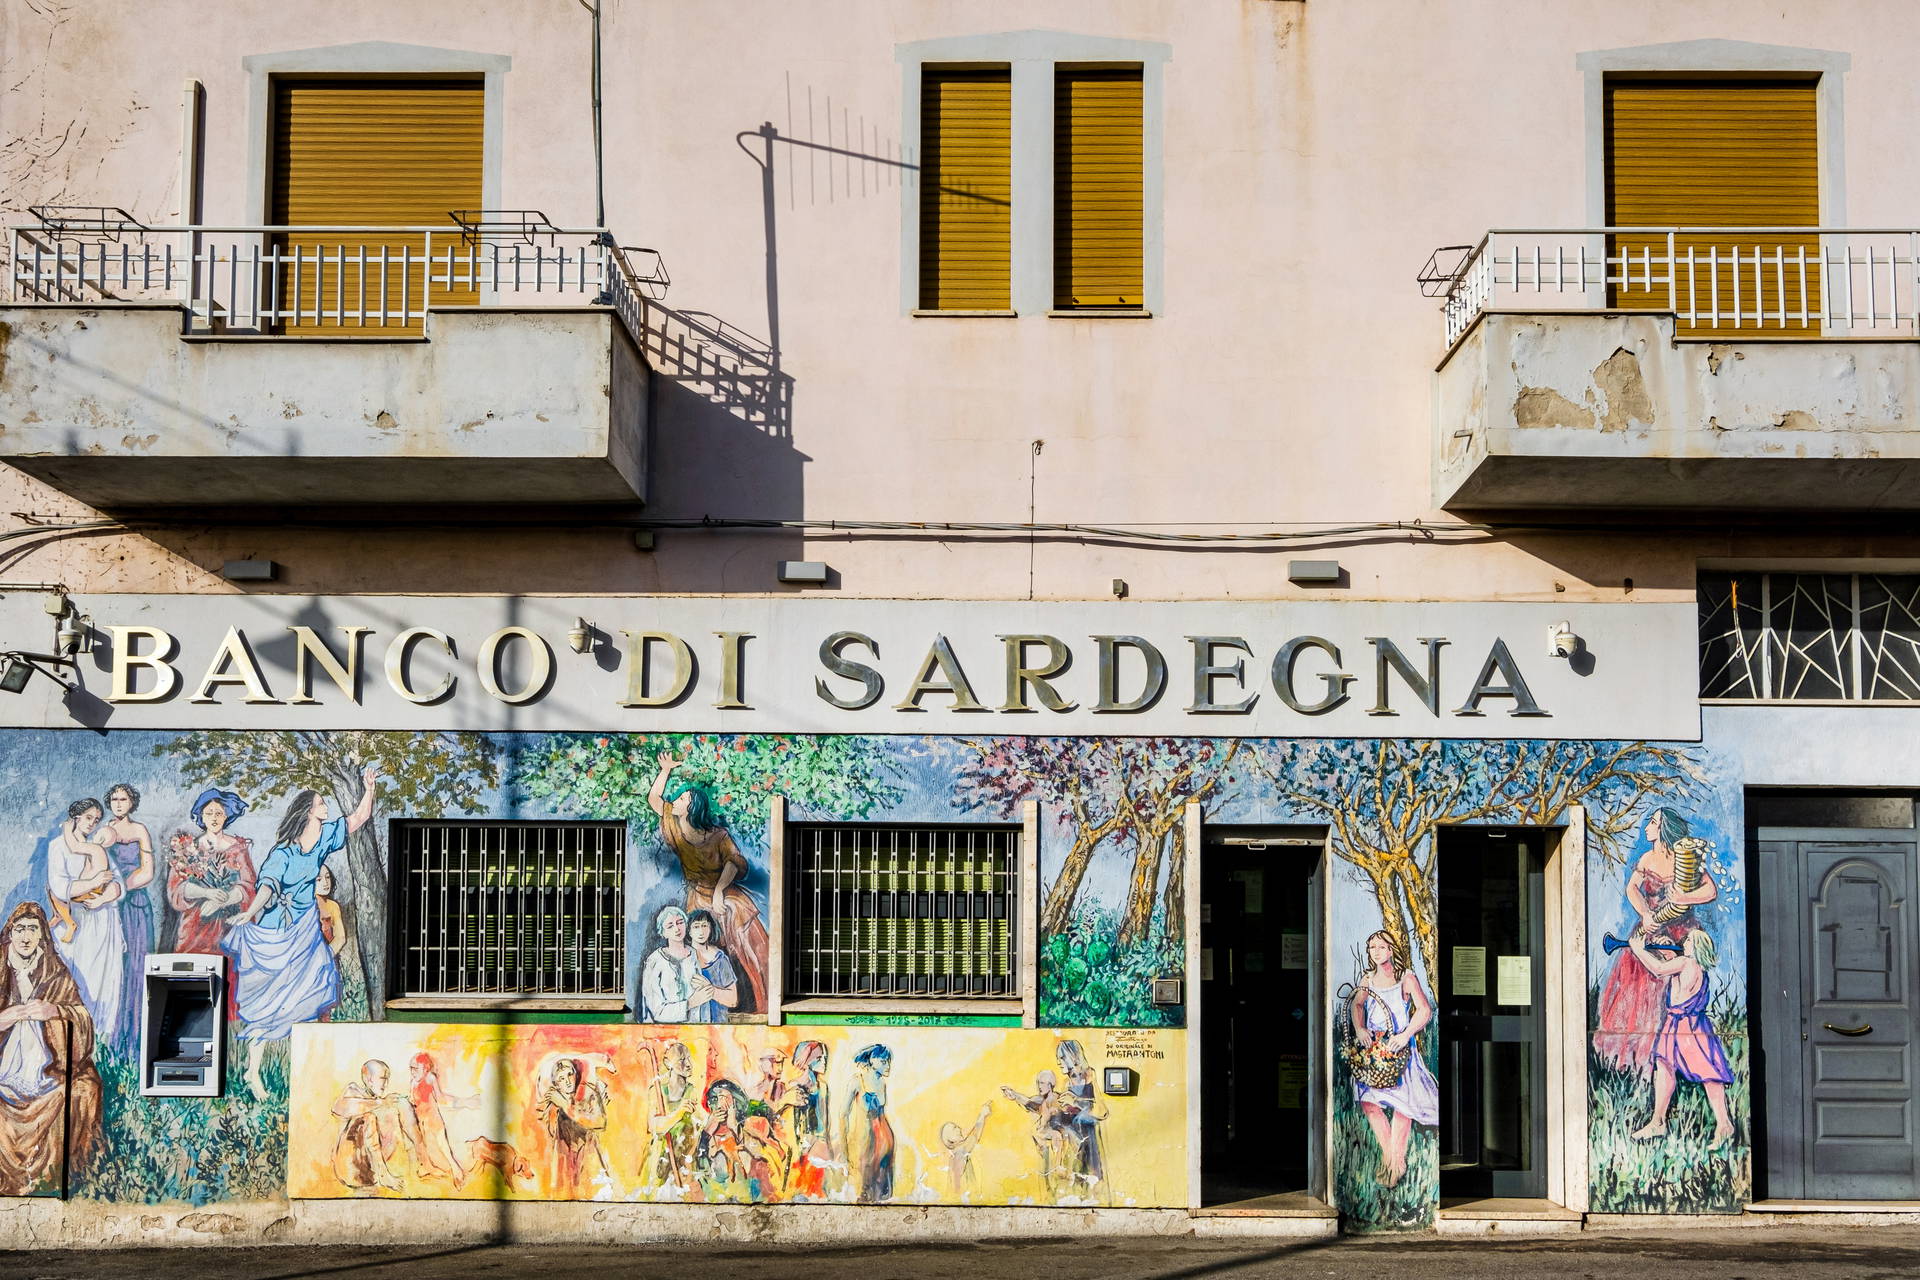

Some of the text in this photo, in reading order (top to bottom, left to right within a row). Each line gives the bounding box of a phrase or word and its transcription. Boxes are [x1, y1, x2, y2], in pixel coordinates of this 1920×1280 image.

[103, 624, 1550, 714] BANCO DI SARDEGNA
